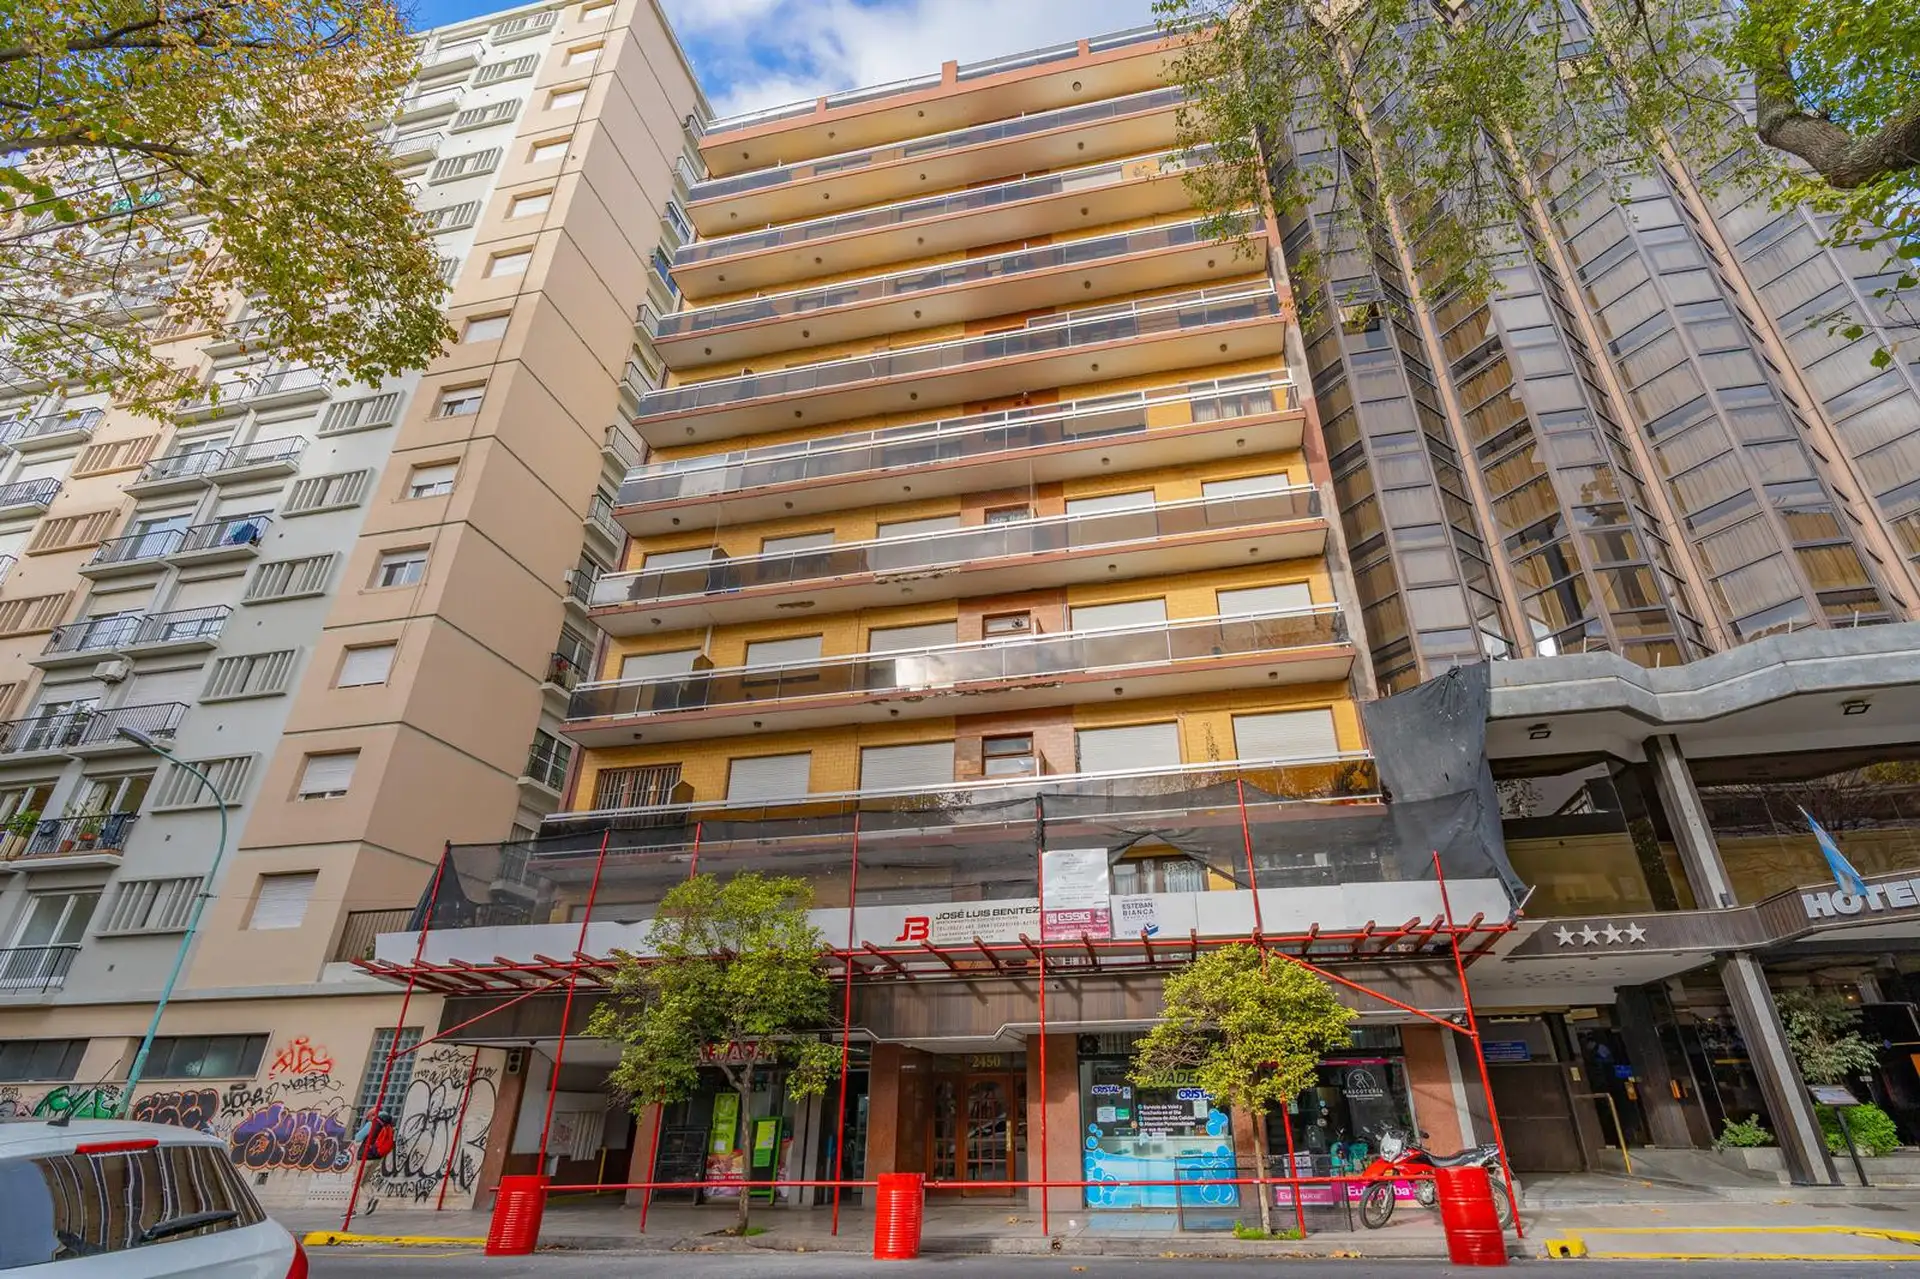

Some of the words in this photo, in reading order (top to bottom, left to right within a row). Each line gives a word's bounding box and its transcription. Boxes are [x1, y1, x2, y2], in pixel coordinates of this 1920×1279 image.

[936, 909, 965, 920] JOSÉ
[966, 908, 991, 919] LUIS
[992, 906, 1040, 917] BENITEZ
[1122, 902, 1153, 910] ESTEBAN
[896, 916, 930, 942] JB
